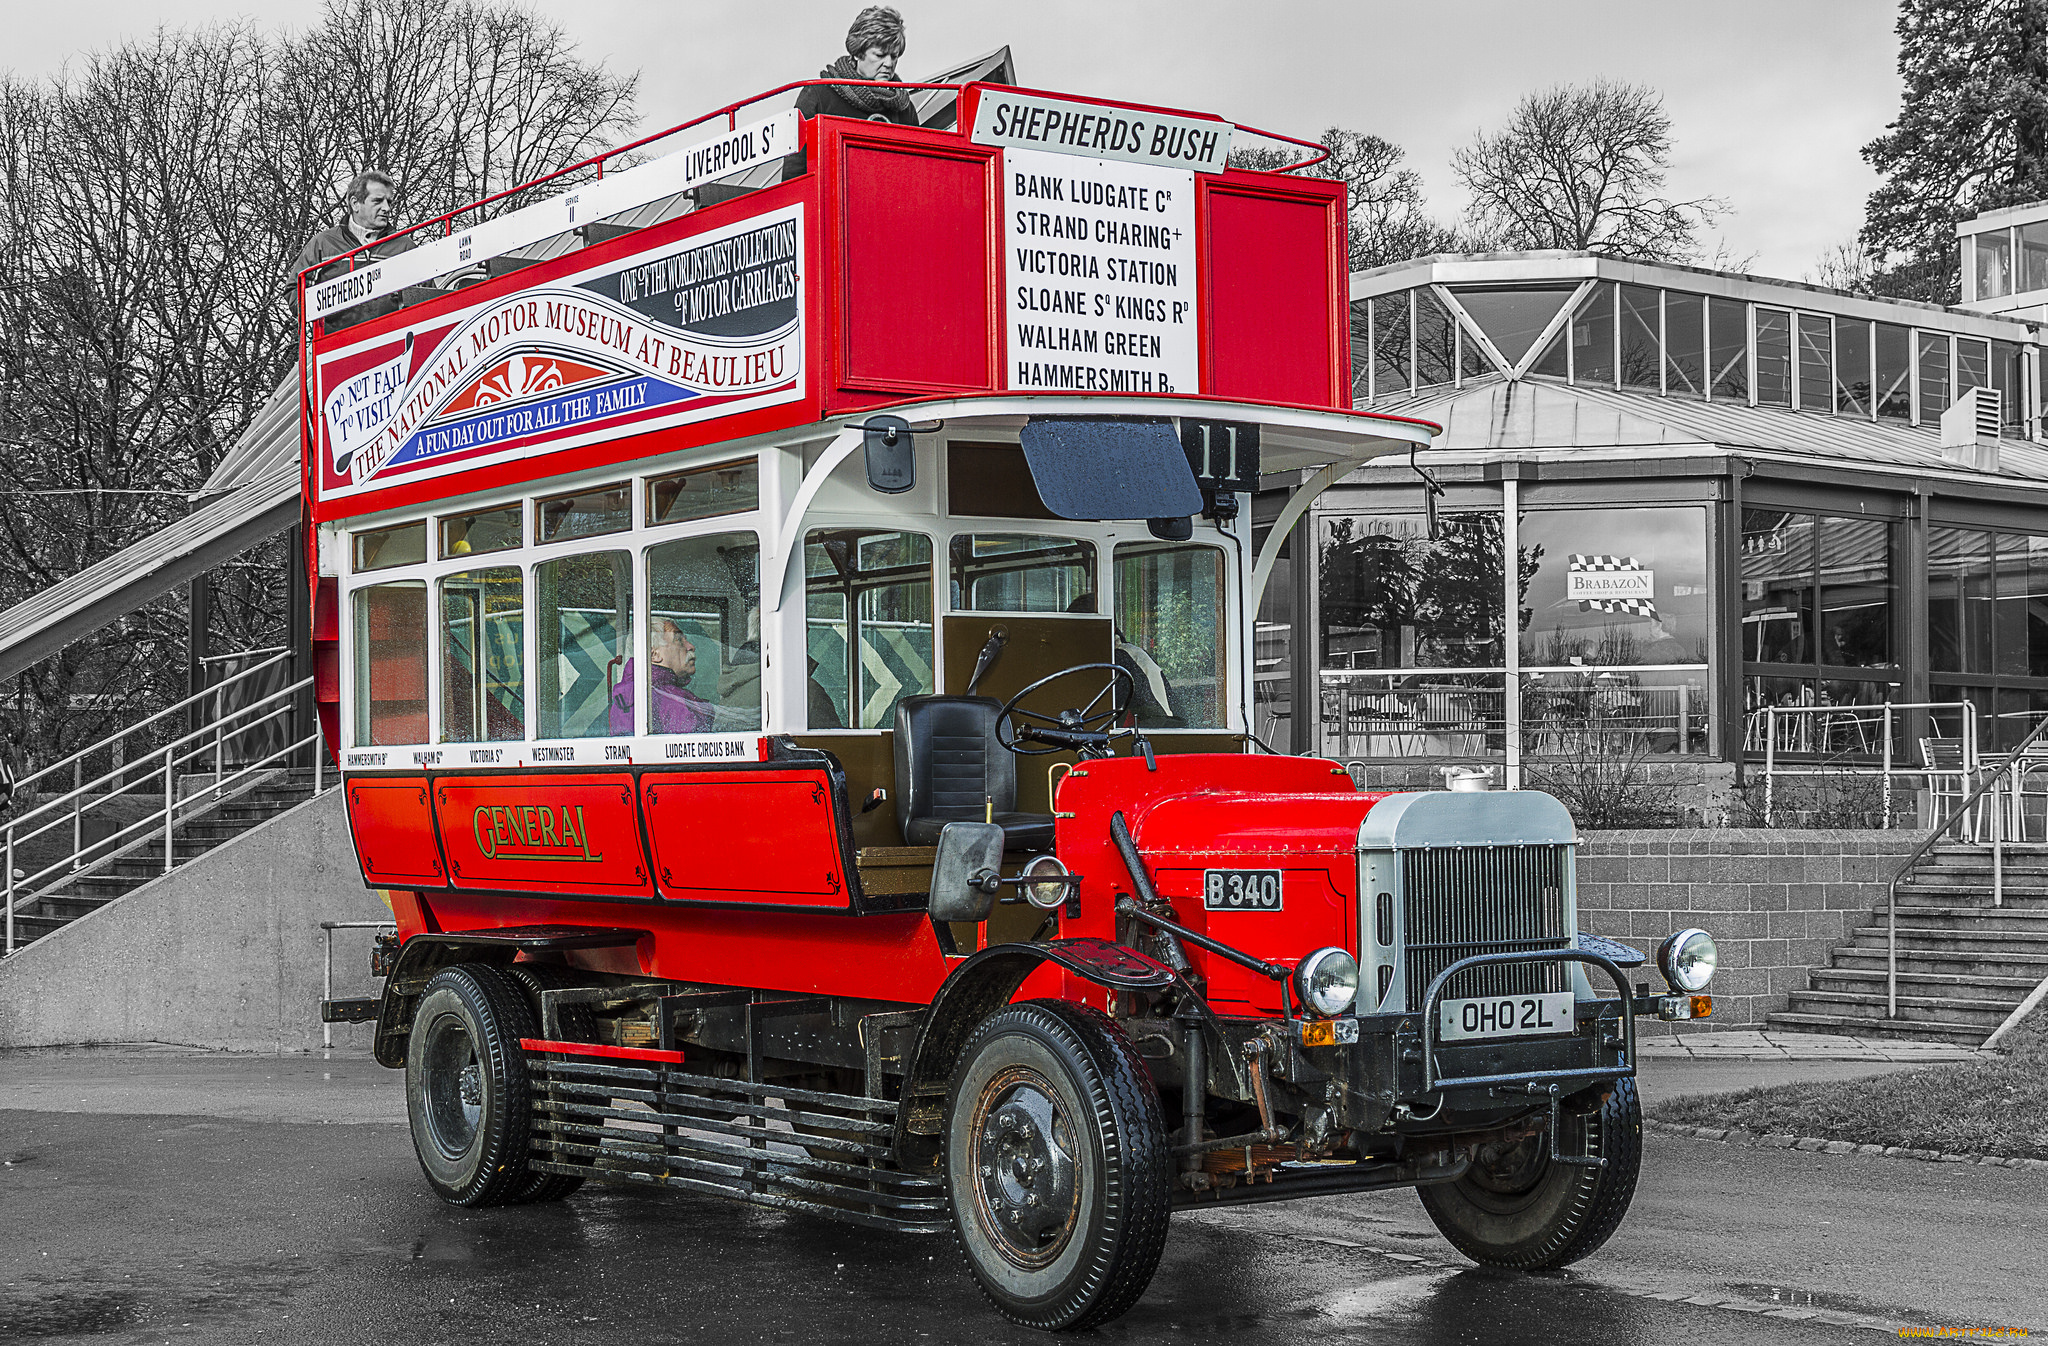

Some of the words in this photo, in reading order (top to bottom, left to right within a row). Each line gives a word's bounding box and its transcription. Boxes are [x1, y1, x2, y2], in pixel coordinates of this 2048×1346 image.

[993, 103, 1145, 154] SHEPHERDS
[1150, 125, 1219, 163] BUSH
[686, 132, 756, 182] LIVERPOOL
[565, 195, 579, 207] SERVICE
[1015, 173, 1063, 201] BANK
[1071, 179, 1149, 212] LUDGATE
[459, 235, 472, 249] LAWN
[1016, 211, 1088, 241] STRAND
[459, 248, 472, 262] ROAD
[620, 269, 638, 304] ONE
[637, 263, 649, 298] OF
[650, 263, 667, 296] THE
[702, 240, 733, 280] FINEST
[733, 220, 795, 272] COLLECTIONS
[1017, 248, 1100, 279] VICTORIA
[1107, 258, 1177, 287] STATION
[317, 275, 364, 312] SHEPHERDS
[674, 286, 688, 326] OF
[689, 279, 731, 324] MOTOR
[731, 260, 795, 312] CARRIAGES
[1017, 286, 1087, 316] SLOANE
[1116, 296, 1166, 323] KINGS
[1173, 301, 1189, 324] RD
[1018, 324, 1098, 353] WALHAM
[1104, 331, 1161, 359] GREEN
[331, 393, 345, 426] DO
[348, 376, 370, 408] NOT
[374, 362, 406, 395] FAIL
[356, 436, 386, 480] THE
[387, 346, 469, 451] NATIONAL
[471, 301, 539, 359] MOTOR
[545, 301, 633, 355] MUSEUM
[635, 333, 665, 369] AT
[667, 344, 785, 386] BEAULIEU
[1018, 362, 1151, 392] HAMMERSMITH
[340, 414, 354, 443] TO
[356, 392, 393, 432] VISIT
[416, 435, 425, 456] A
[426, 429, 450, 453] FUN
[452, 425, 476, 448] DAY
[477, 418, 506, 442] OUT
[506, 410, 534, 435] FOR
[534, 404, 561, 430] ALL
[562, 396, 591, 422] THE
[595, 382, 648, 416] FAMILY
[1199, 425, 1241, 481] 11
[1573, 575, 1649, 590] BRABAZON
[347, 753, 382, 767] HAMMERSMITH
[413, 751, 436, 765] WALHAM
[469, 750, 495, 764] VICTORIA
[531, 746, 575, 762] WESTMINSTER
[605, 745, 631, 760] STRAND
[665, 742, 698, 759] LUDGATE
[698, 741, 724, 758] CIRCUS
[725, 741, 746, 757] BANK
[473, 805, 603, 862] GENERAL
[1208, 874, 1224, 905] B
[1228, 874, 1276, 906] 340
